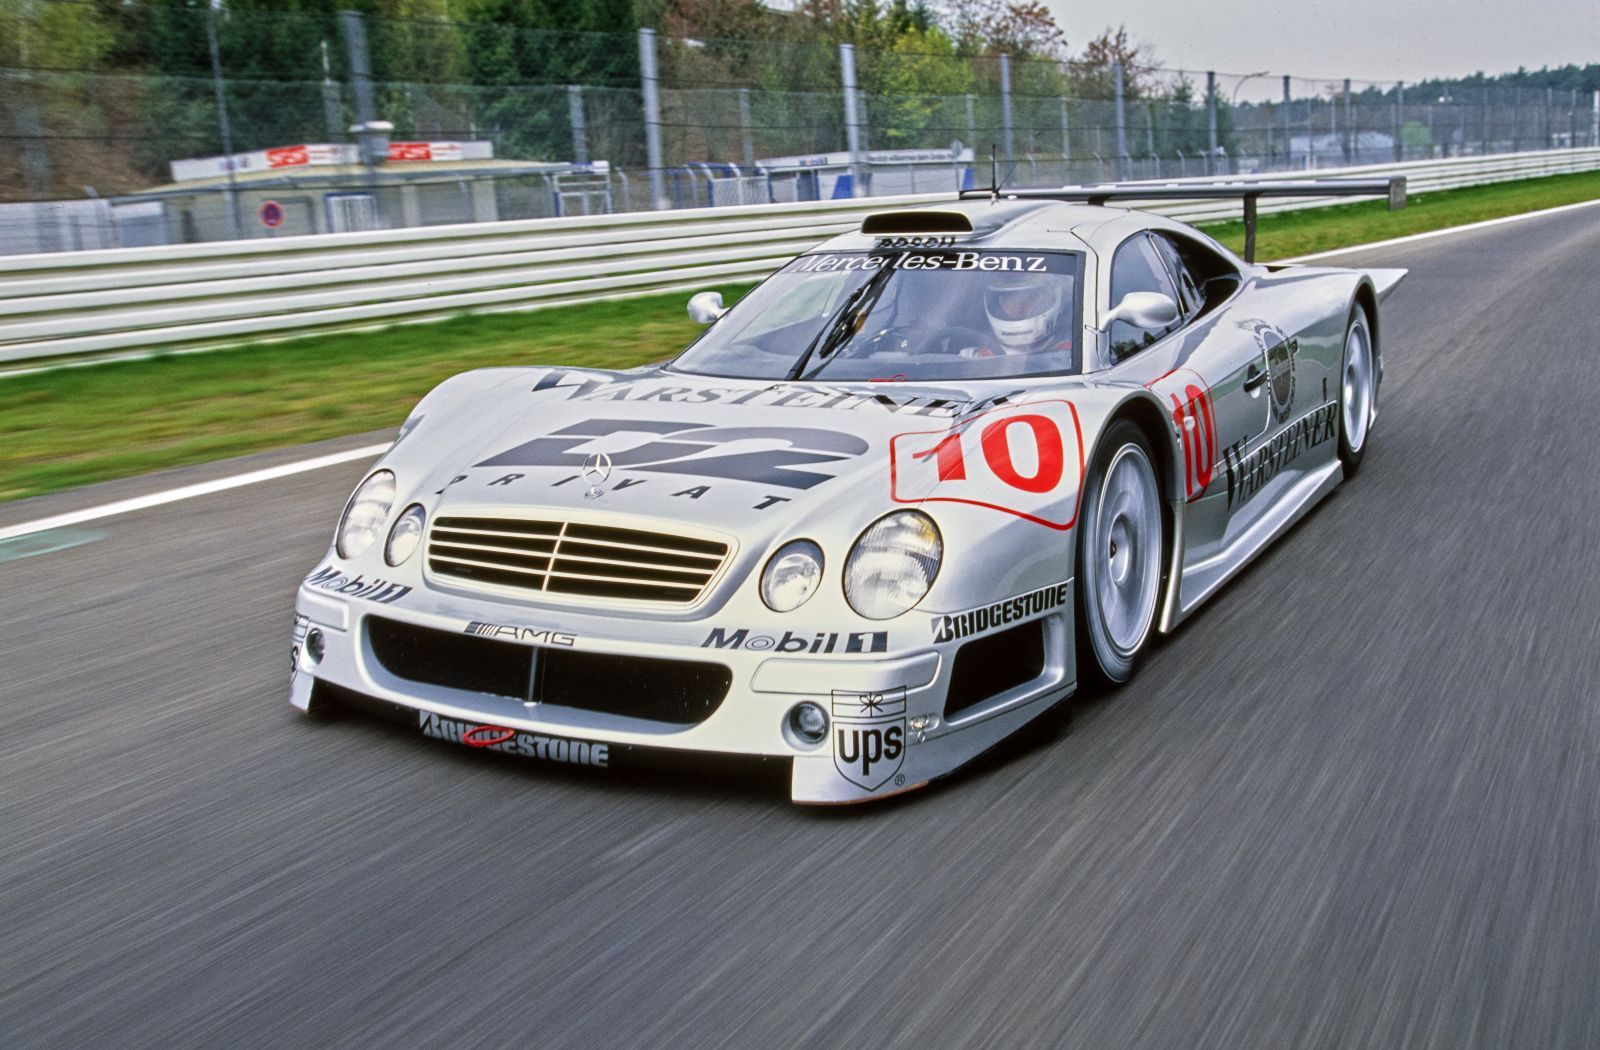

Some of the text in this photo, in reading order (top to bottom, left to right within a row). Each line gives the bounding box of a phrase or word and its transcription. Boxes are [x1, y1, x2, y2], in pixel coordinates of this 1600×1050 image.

[912, 414, 1064, 494] 10
[1169, 384, 1213, 498] 10
[1222, 402, 1337, 513] WARSTEINER
[434, 473, 793, 511] PRIVAT
[307, 565, 387, 598] Mobil
[701, 628, 838, 654] Mobil
[930, 583, 1067, 645] BRIDGESTONE
[838, 723, 903, 777] ups
